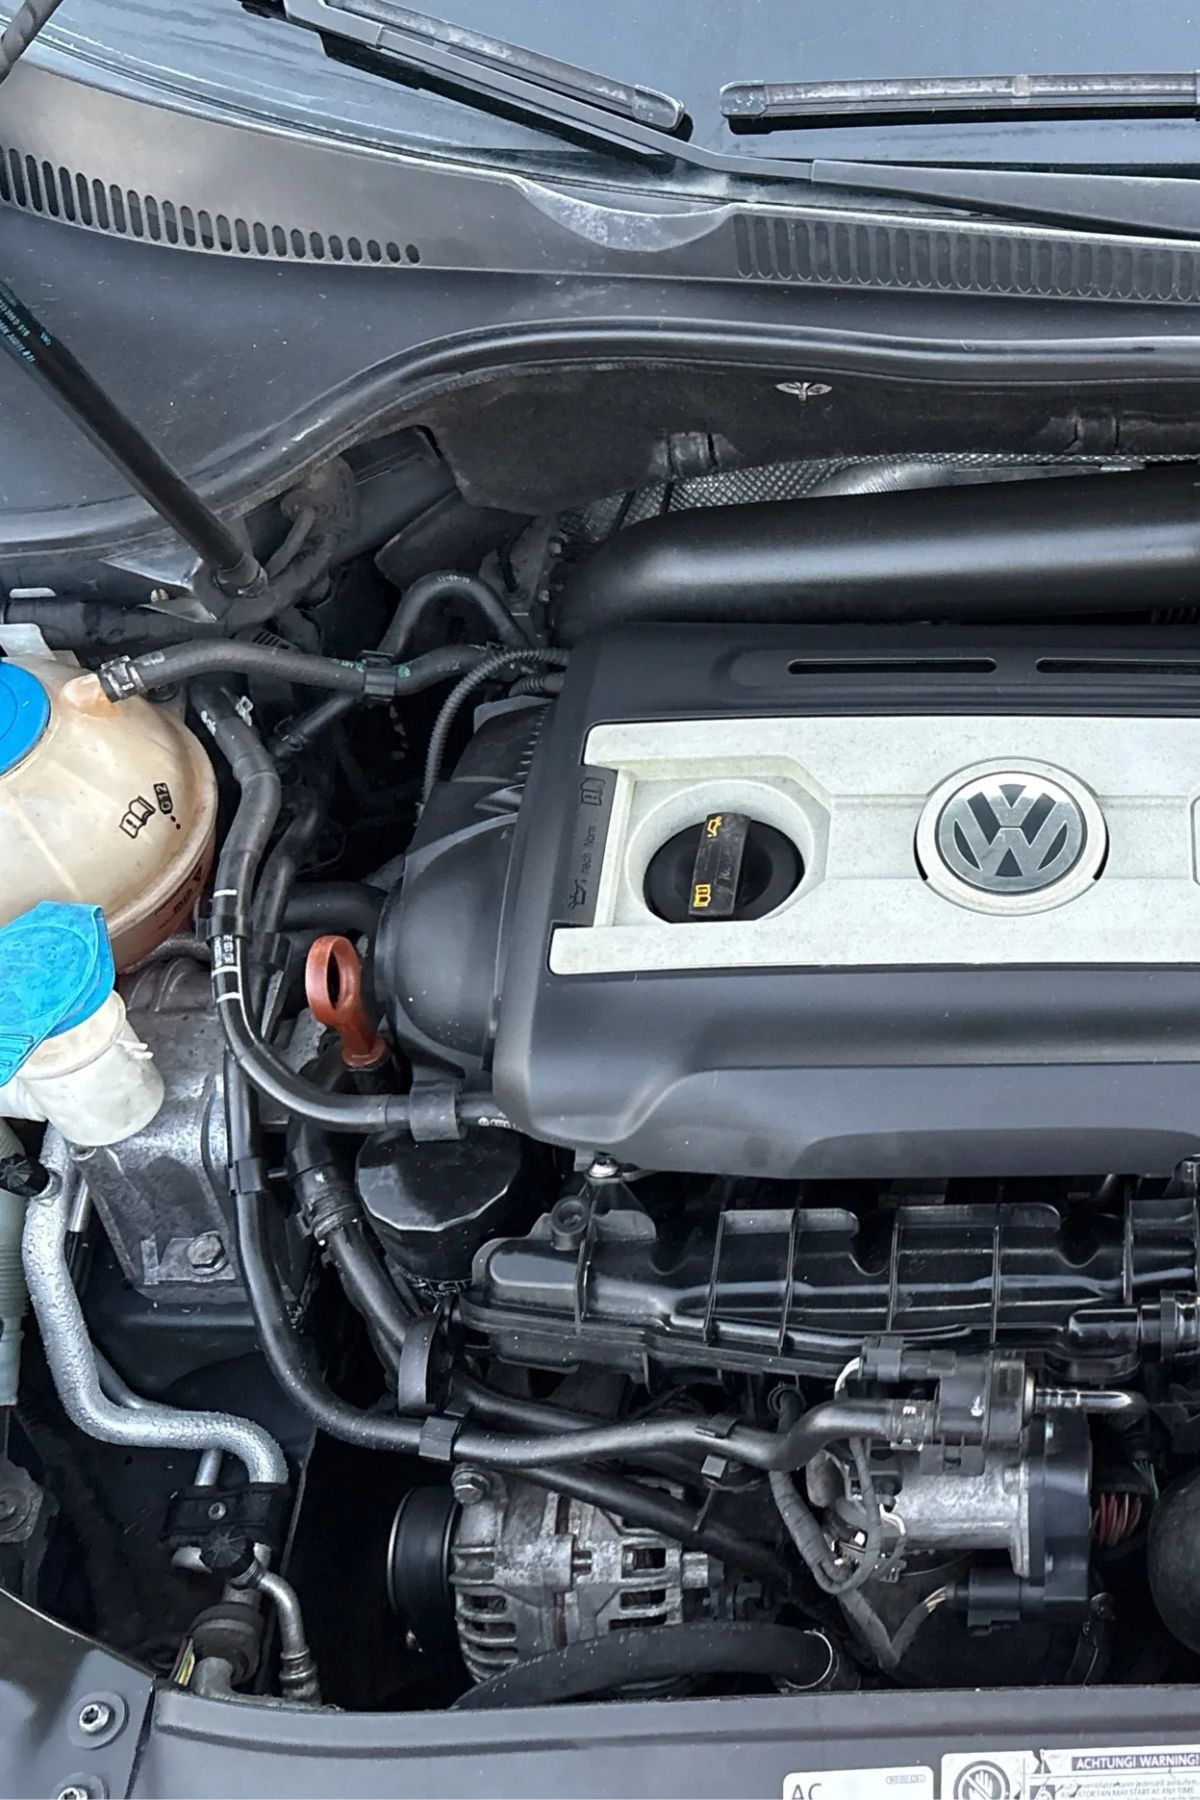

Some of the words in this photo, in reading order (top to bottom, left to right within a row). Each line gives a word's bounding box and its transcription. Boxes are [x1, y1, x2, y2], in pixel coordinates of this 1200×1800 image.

[156, 784, 172, 811] G12
[1076, 1756, 1137, 1770] ACHTUNG!
[1140, 1754, 1200, 1768] WARNING!
